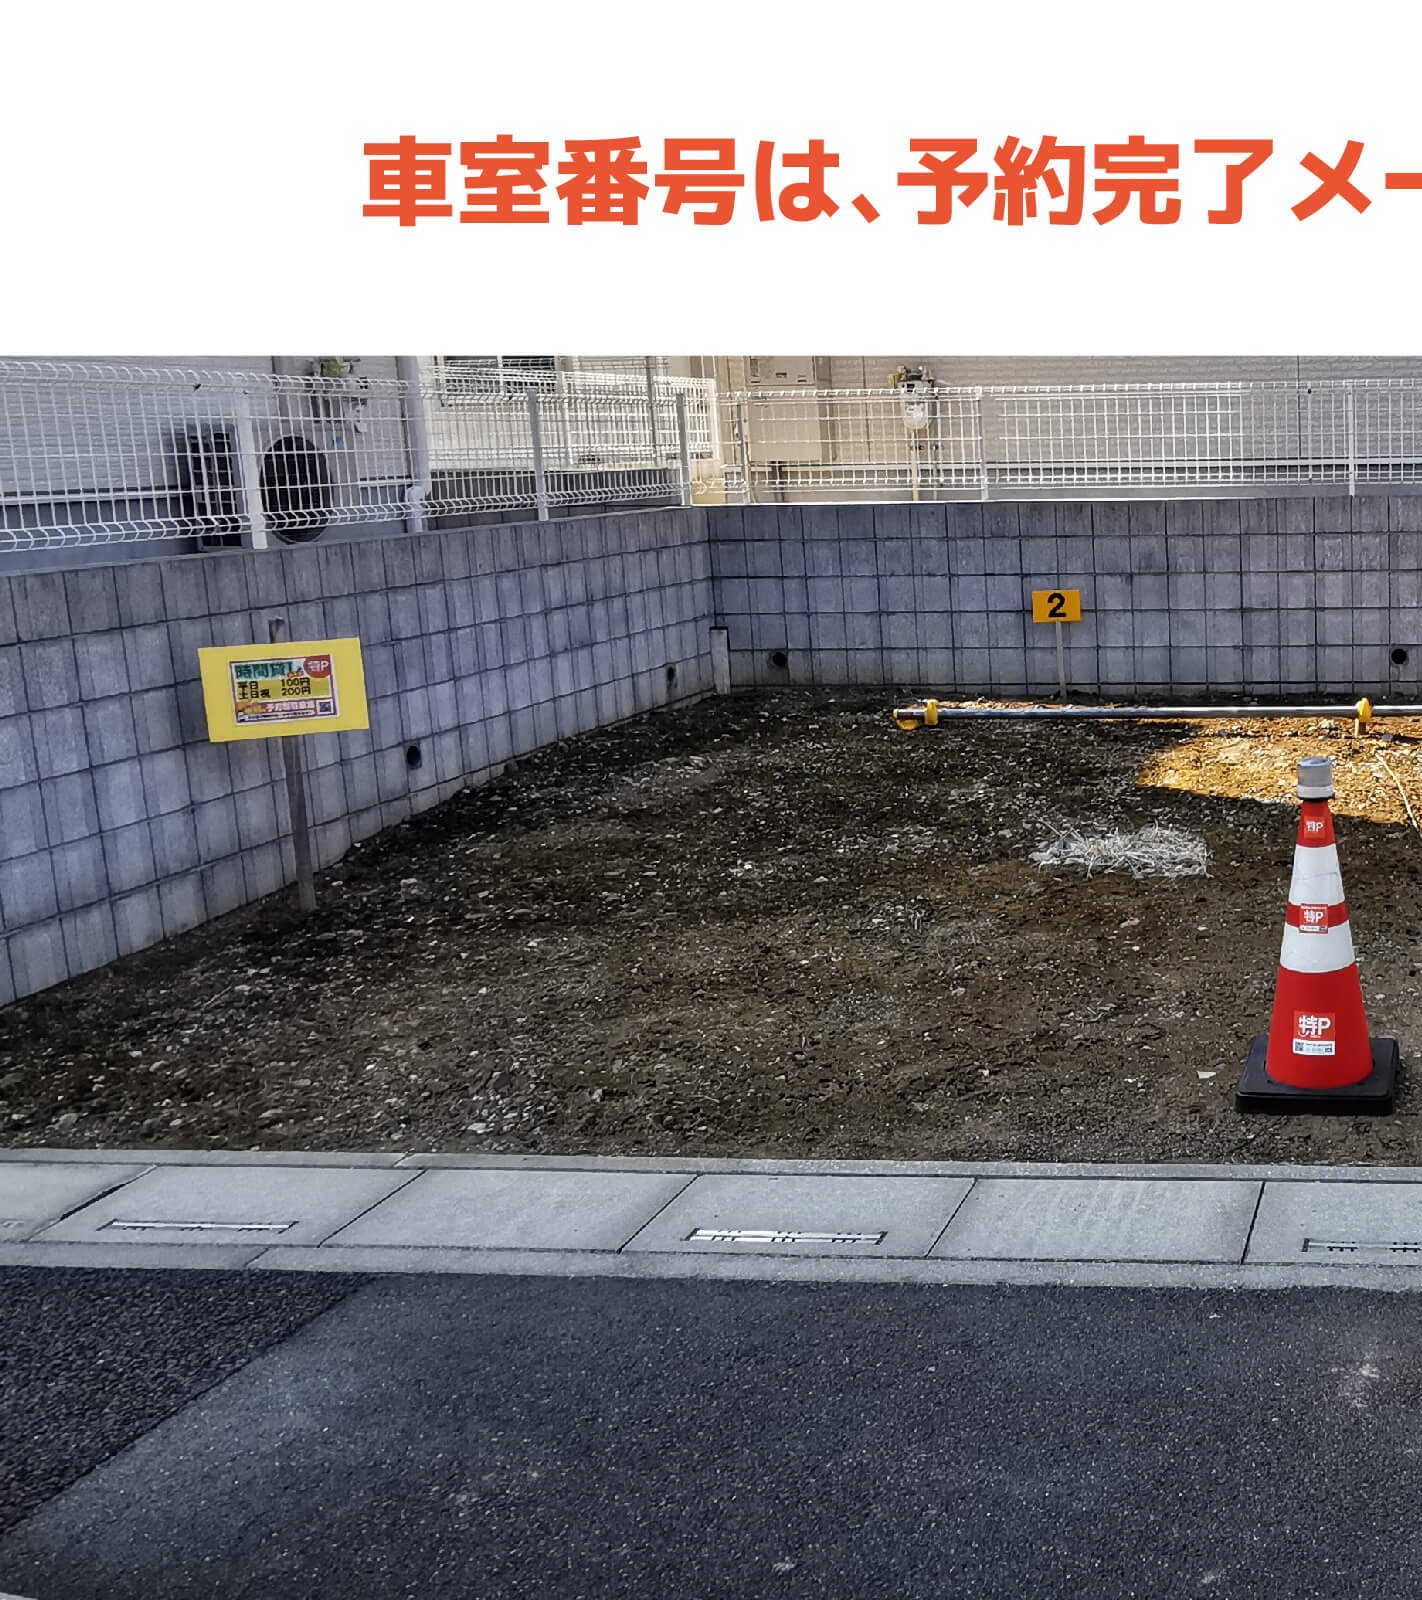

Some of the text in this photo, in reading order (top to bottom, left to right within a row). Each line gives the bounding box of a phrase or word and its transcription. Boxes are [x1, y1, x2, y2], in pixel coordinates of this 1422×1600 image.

[1047, 592, 1067, 618] 2
[281, 677, 311, 688] 100円
[281, 686, 312, 697] 200円
[1298, 1015, 1332, 1037] 特P
